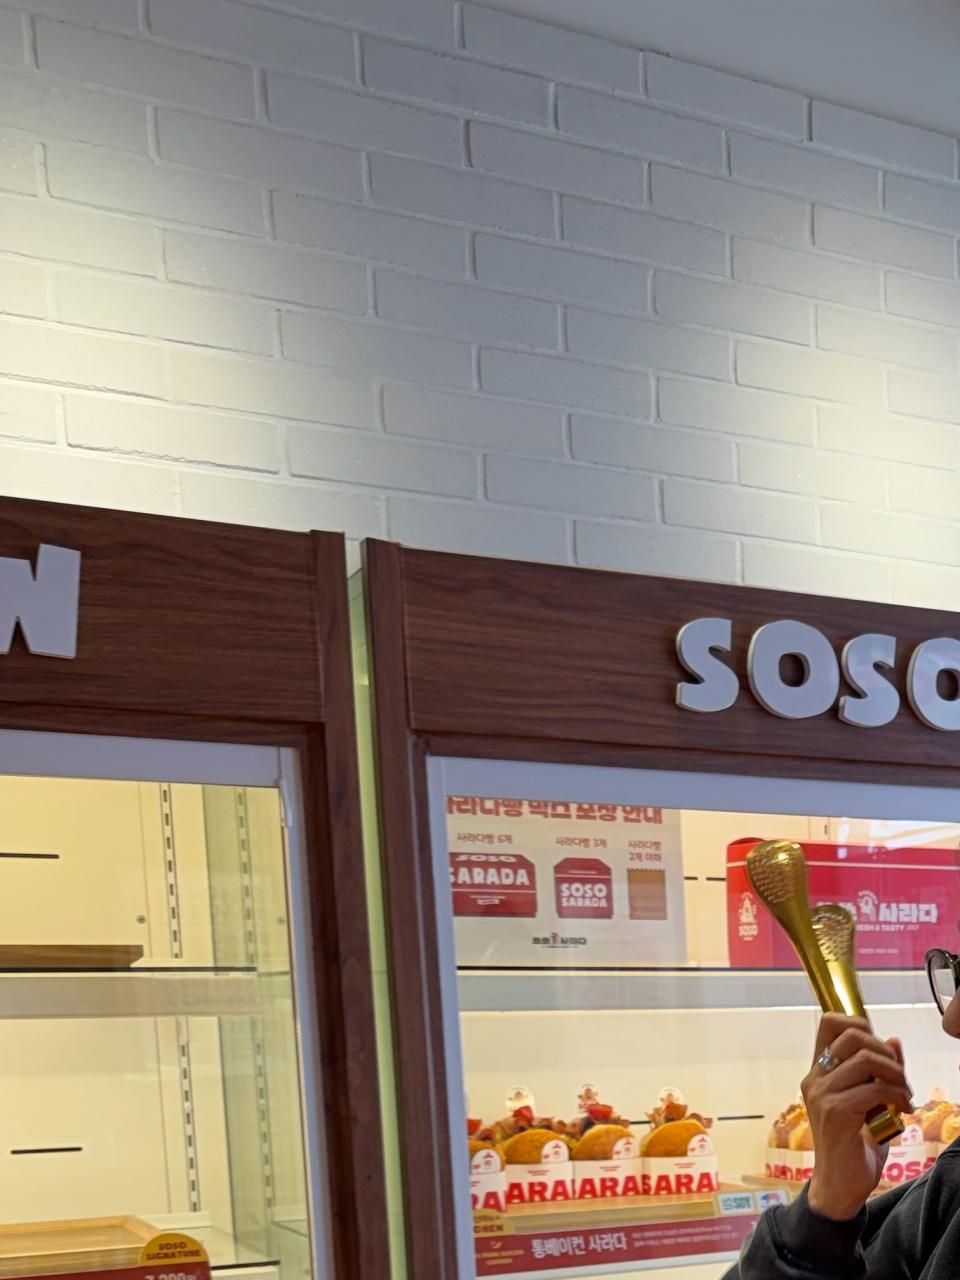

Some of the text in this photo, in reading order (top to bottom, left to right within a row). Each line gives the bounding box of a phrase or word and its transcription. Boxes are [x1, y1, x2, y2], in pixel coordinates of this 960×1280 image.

[560, 882, 607, 898] SOSO
[561, 898, 608, 908] SARADA
[879, 903, 938, 923] 사라다
[158, 1241, 188, 1251] SOSO
[588, 1231, 628, 1252] 사라다
[146, 1249, 201, 1261] SIGNATURE
